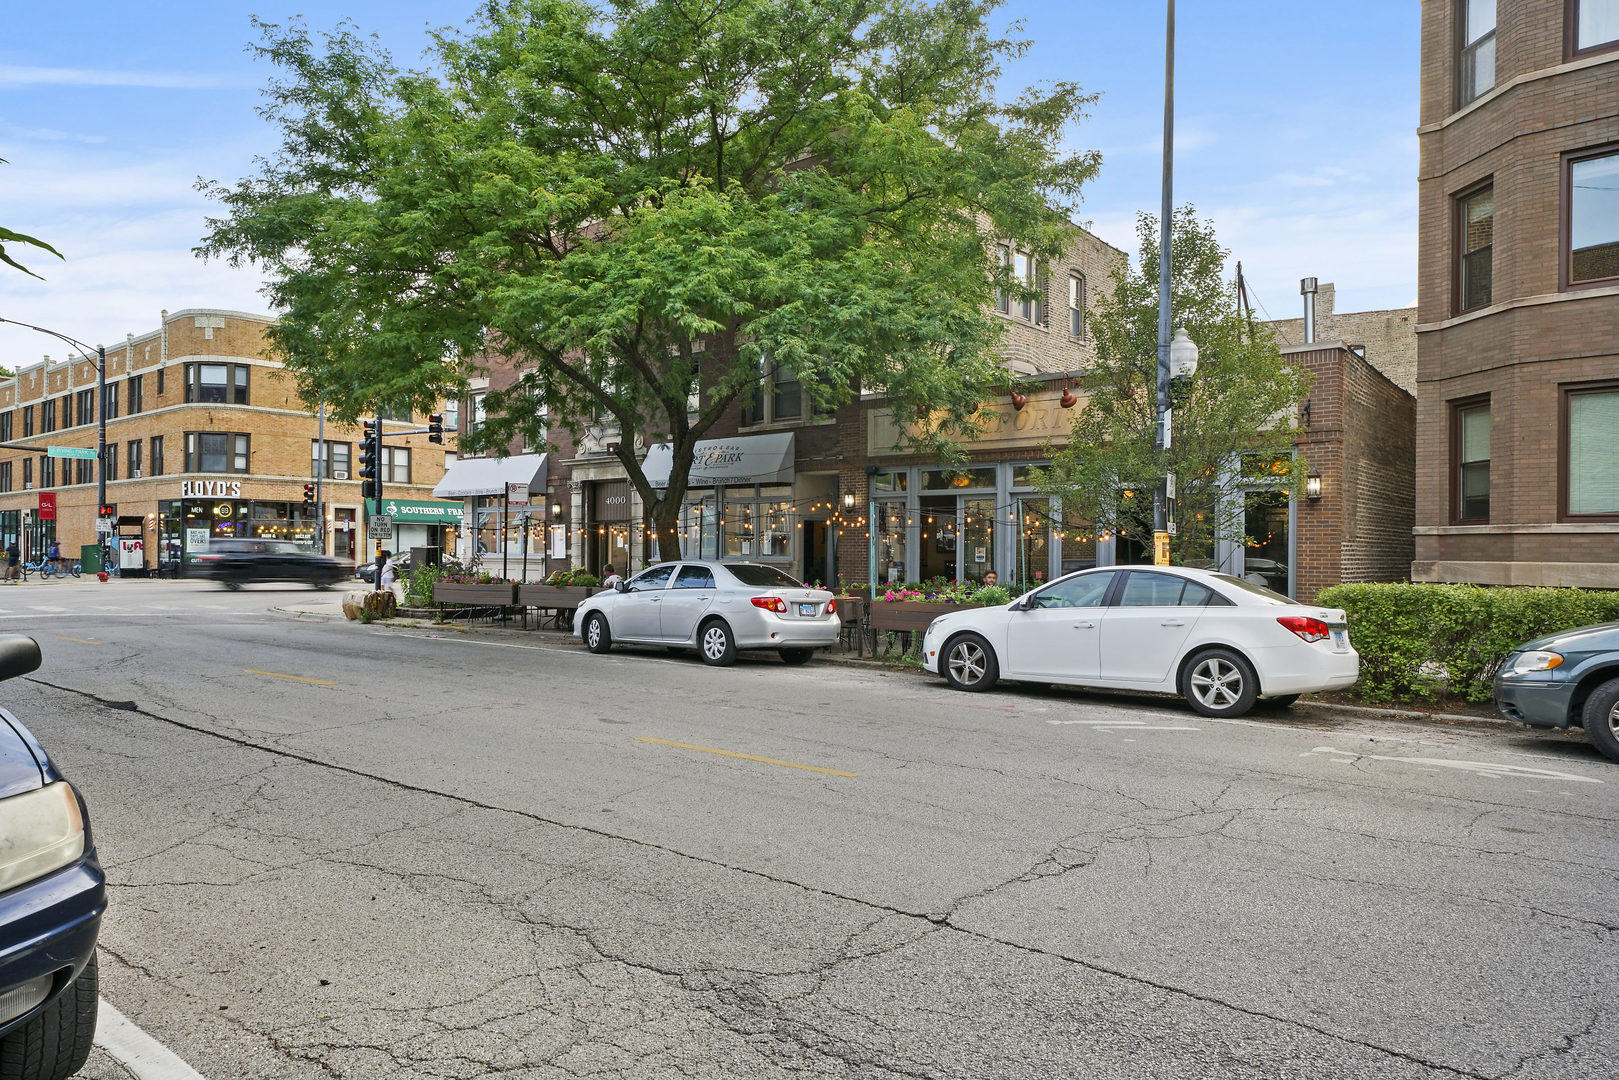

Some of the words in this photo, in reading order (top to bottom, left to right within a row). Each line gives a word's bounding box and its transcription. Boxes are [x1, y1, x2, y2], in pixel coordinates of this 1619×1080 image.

[715, 452, 744, 463] PARK
[182, 481, 241, 498] FLOYD'S
[605, 495, 626, 505] 4000
[400, 506, 445, 515] SOUTHERN
